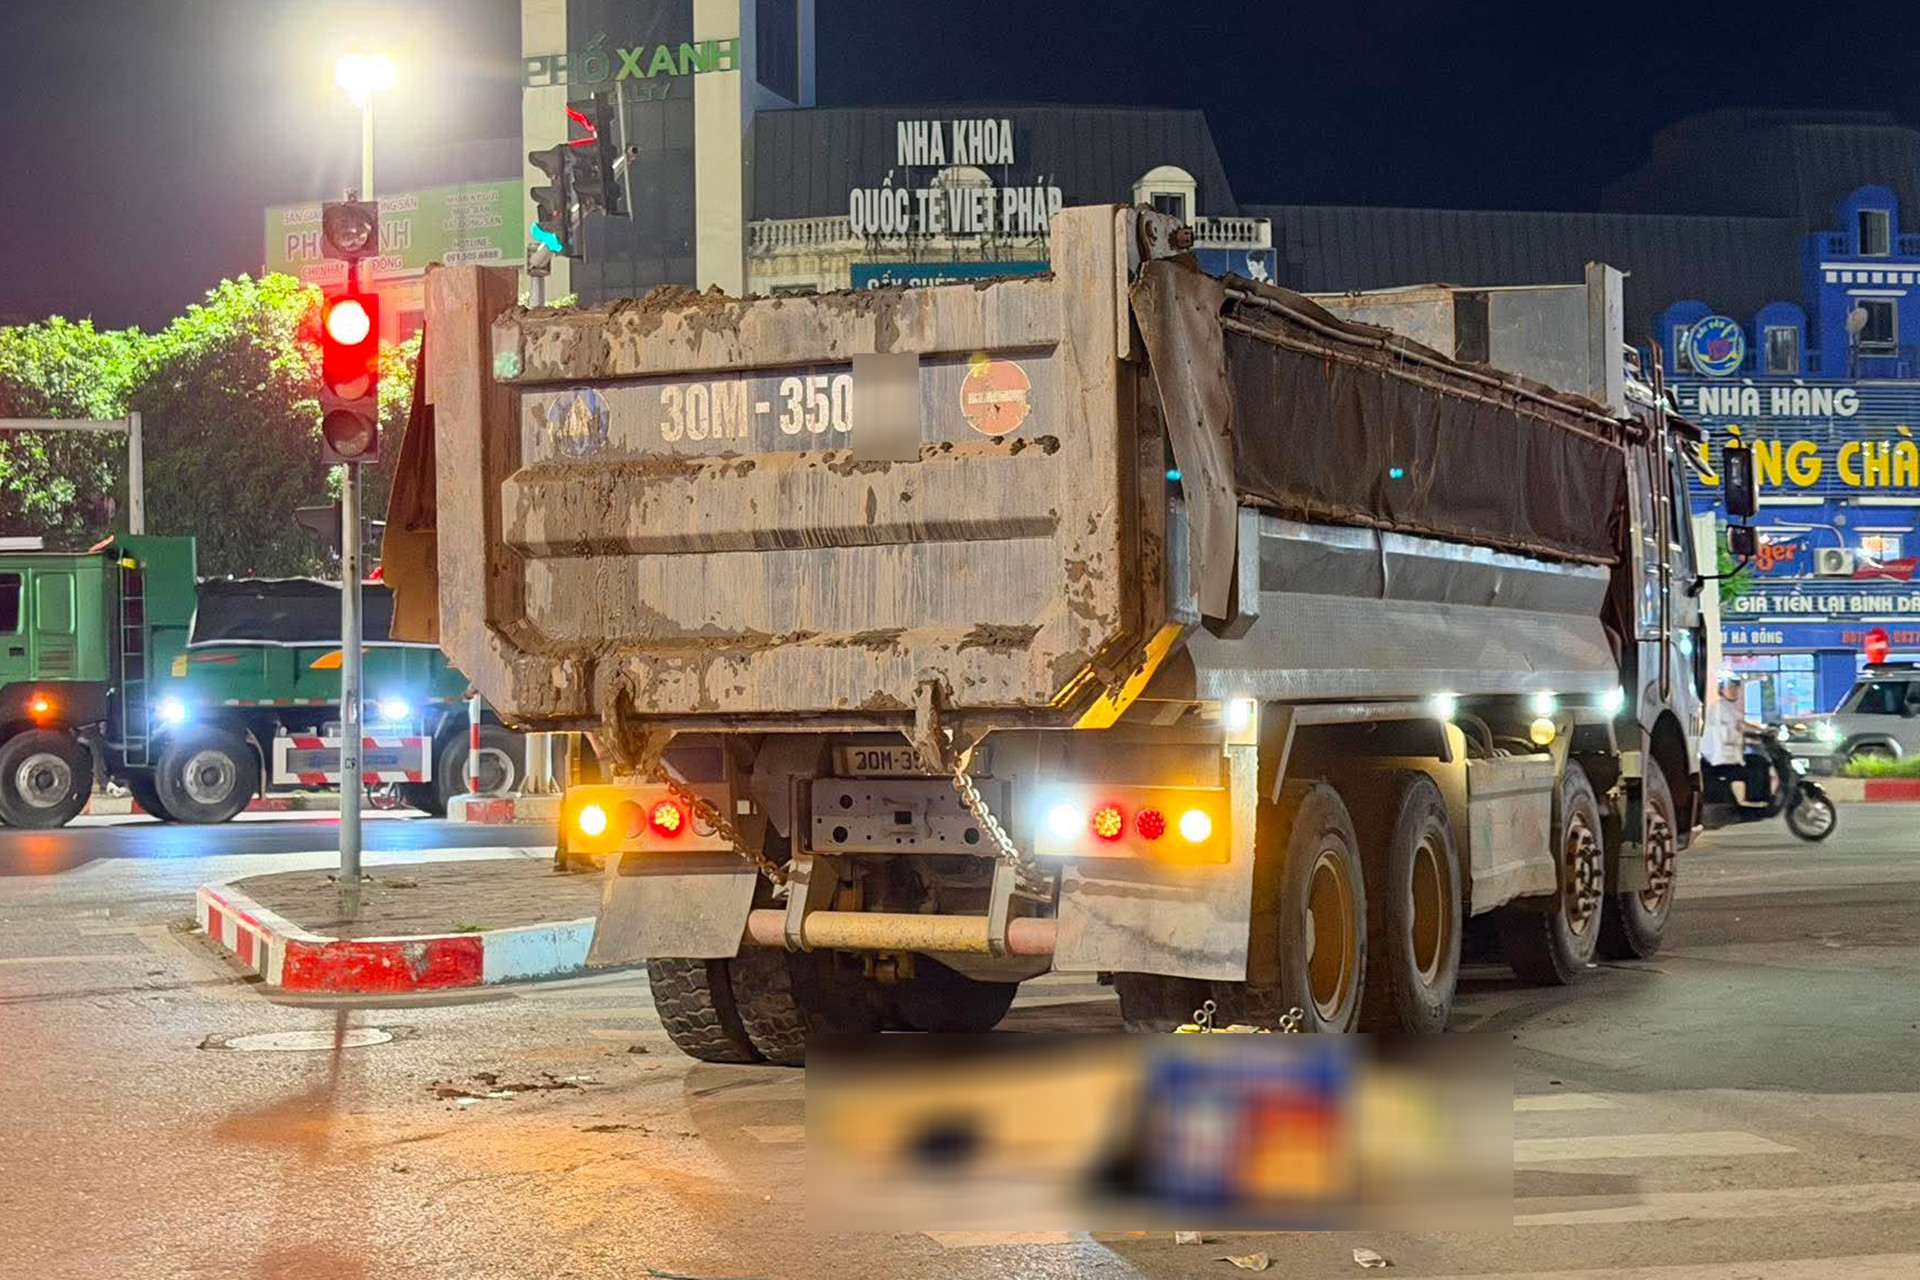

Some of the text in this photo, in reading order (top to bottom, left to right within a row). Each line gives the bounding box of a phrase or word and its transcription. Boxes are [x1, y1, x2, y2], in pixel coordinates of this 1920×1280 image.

[615, 39, 739, 81] XANH
[898, 119, 1014, 166] NHA KHOA
[850, 170, 910, 238] QUỐC
[1003, 175, 1062, 231] PHÁP
[285, 220, 412, 262] PH NH
[660, 380, 748, 442] 30M
[1771, 379, 1860, 416] HÀNG
[1699, 424, 1920, 488] LNG CHÀ
[1740, 544, 1796, 571] ger
[1735, 591, 1768, 613] GIÁ
[1850, 591, 1893, 613] BÌNH
[1732, 626, 1748, 644] HÀ
